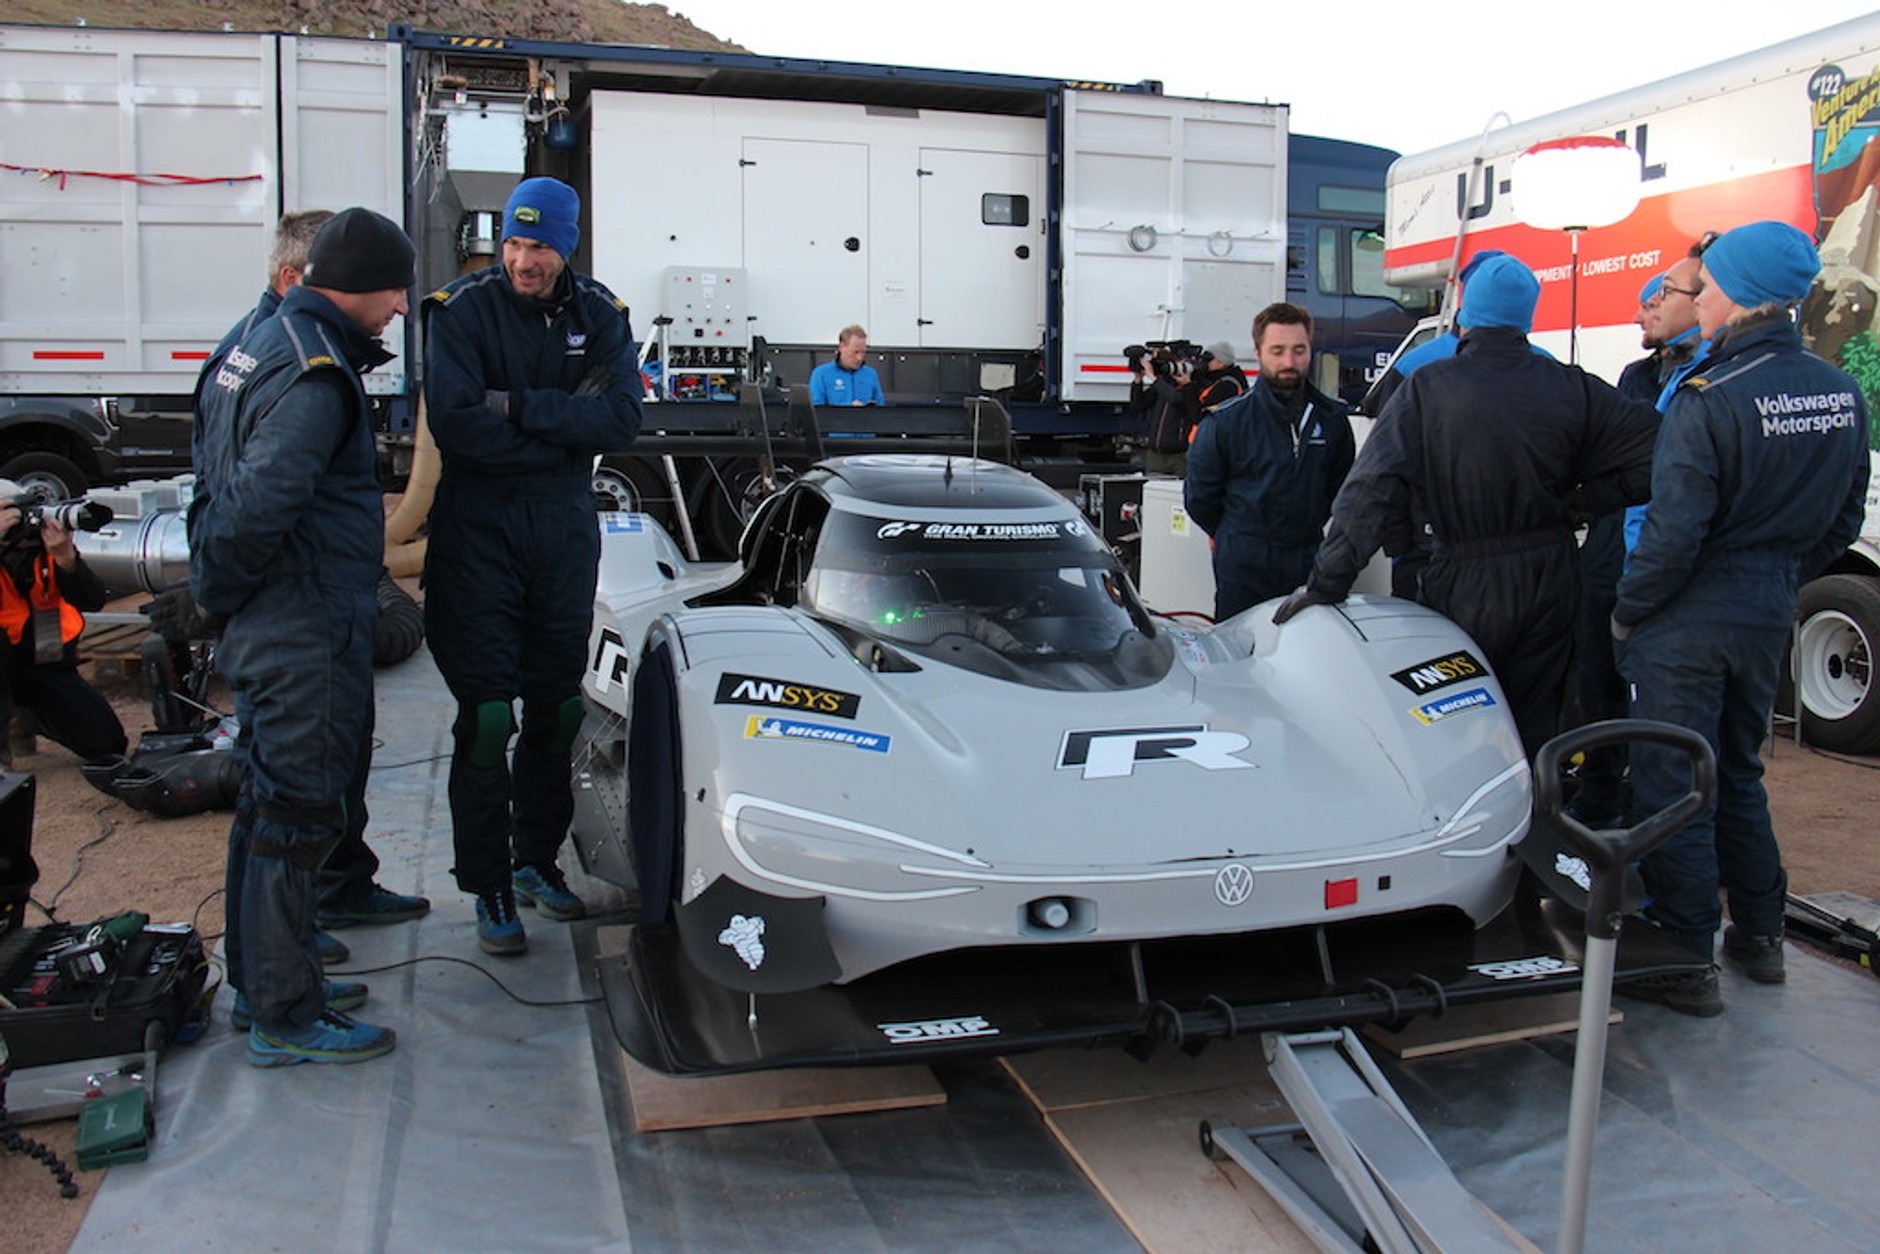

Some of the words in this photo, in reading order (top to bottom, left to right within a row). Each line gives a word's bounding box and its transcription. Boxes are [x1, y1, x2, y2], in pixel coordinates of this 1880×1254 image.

[1811, 74, 1842, 96] #122
[1582, 255, 1627, 277] LOWEST
[1629, 249, 1661, 270] COST
[1754, 392, 1856, 416] Volkswagen
[1761, 411, 1855, 437] Motorsport
[925, 523, 979, 535] GRAN
[983, 523, 1058, 535] TURISMO
[1410, 657, 1476, 689] ANSYS
[731, 679, 840, 711] ANSYS
[1439, 693, 1487, 713] MICHELIN
[786, 724, 879, 747] MICHELIN
[880, 1018, 995, 1041] OMP
